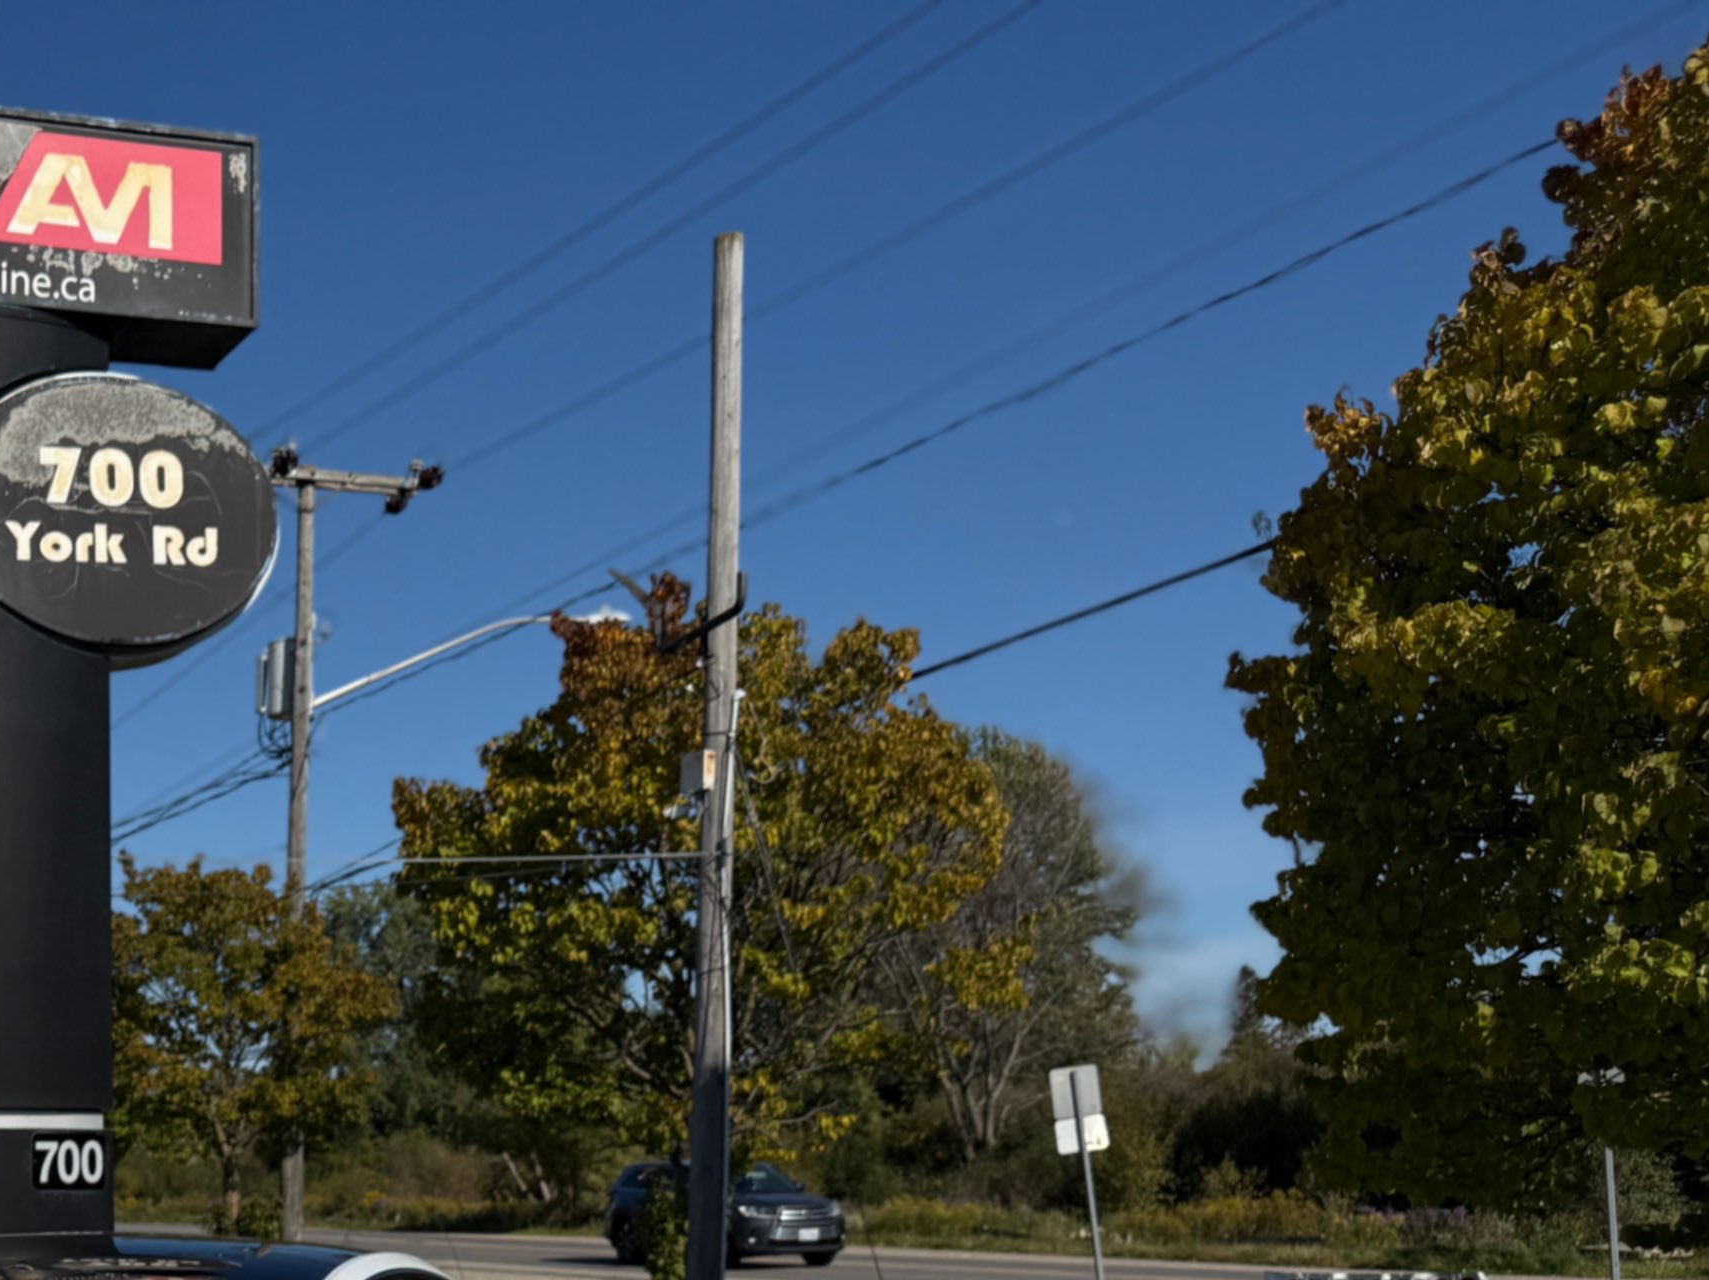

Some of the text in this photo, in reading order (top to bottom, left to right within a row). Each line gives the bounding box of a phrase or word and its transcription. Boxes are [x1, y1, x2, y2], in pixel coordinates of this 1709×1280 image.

[39, 446, 184, 509] 700
[4, 520, 219, 568] York Rd
[34, 1139, 104, 1184] 700
